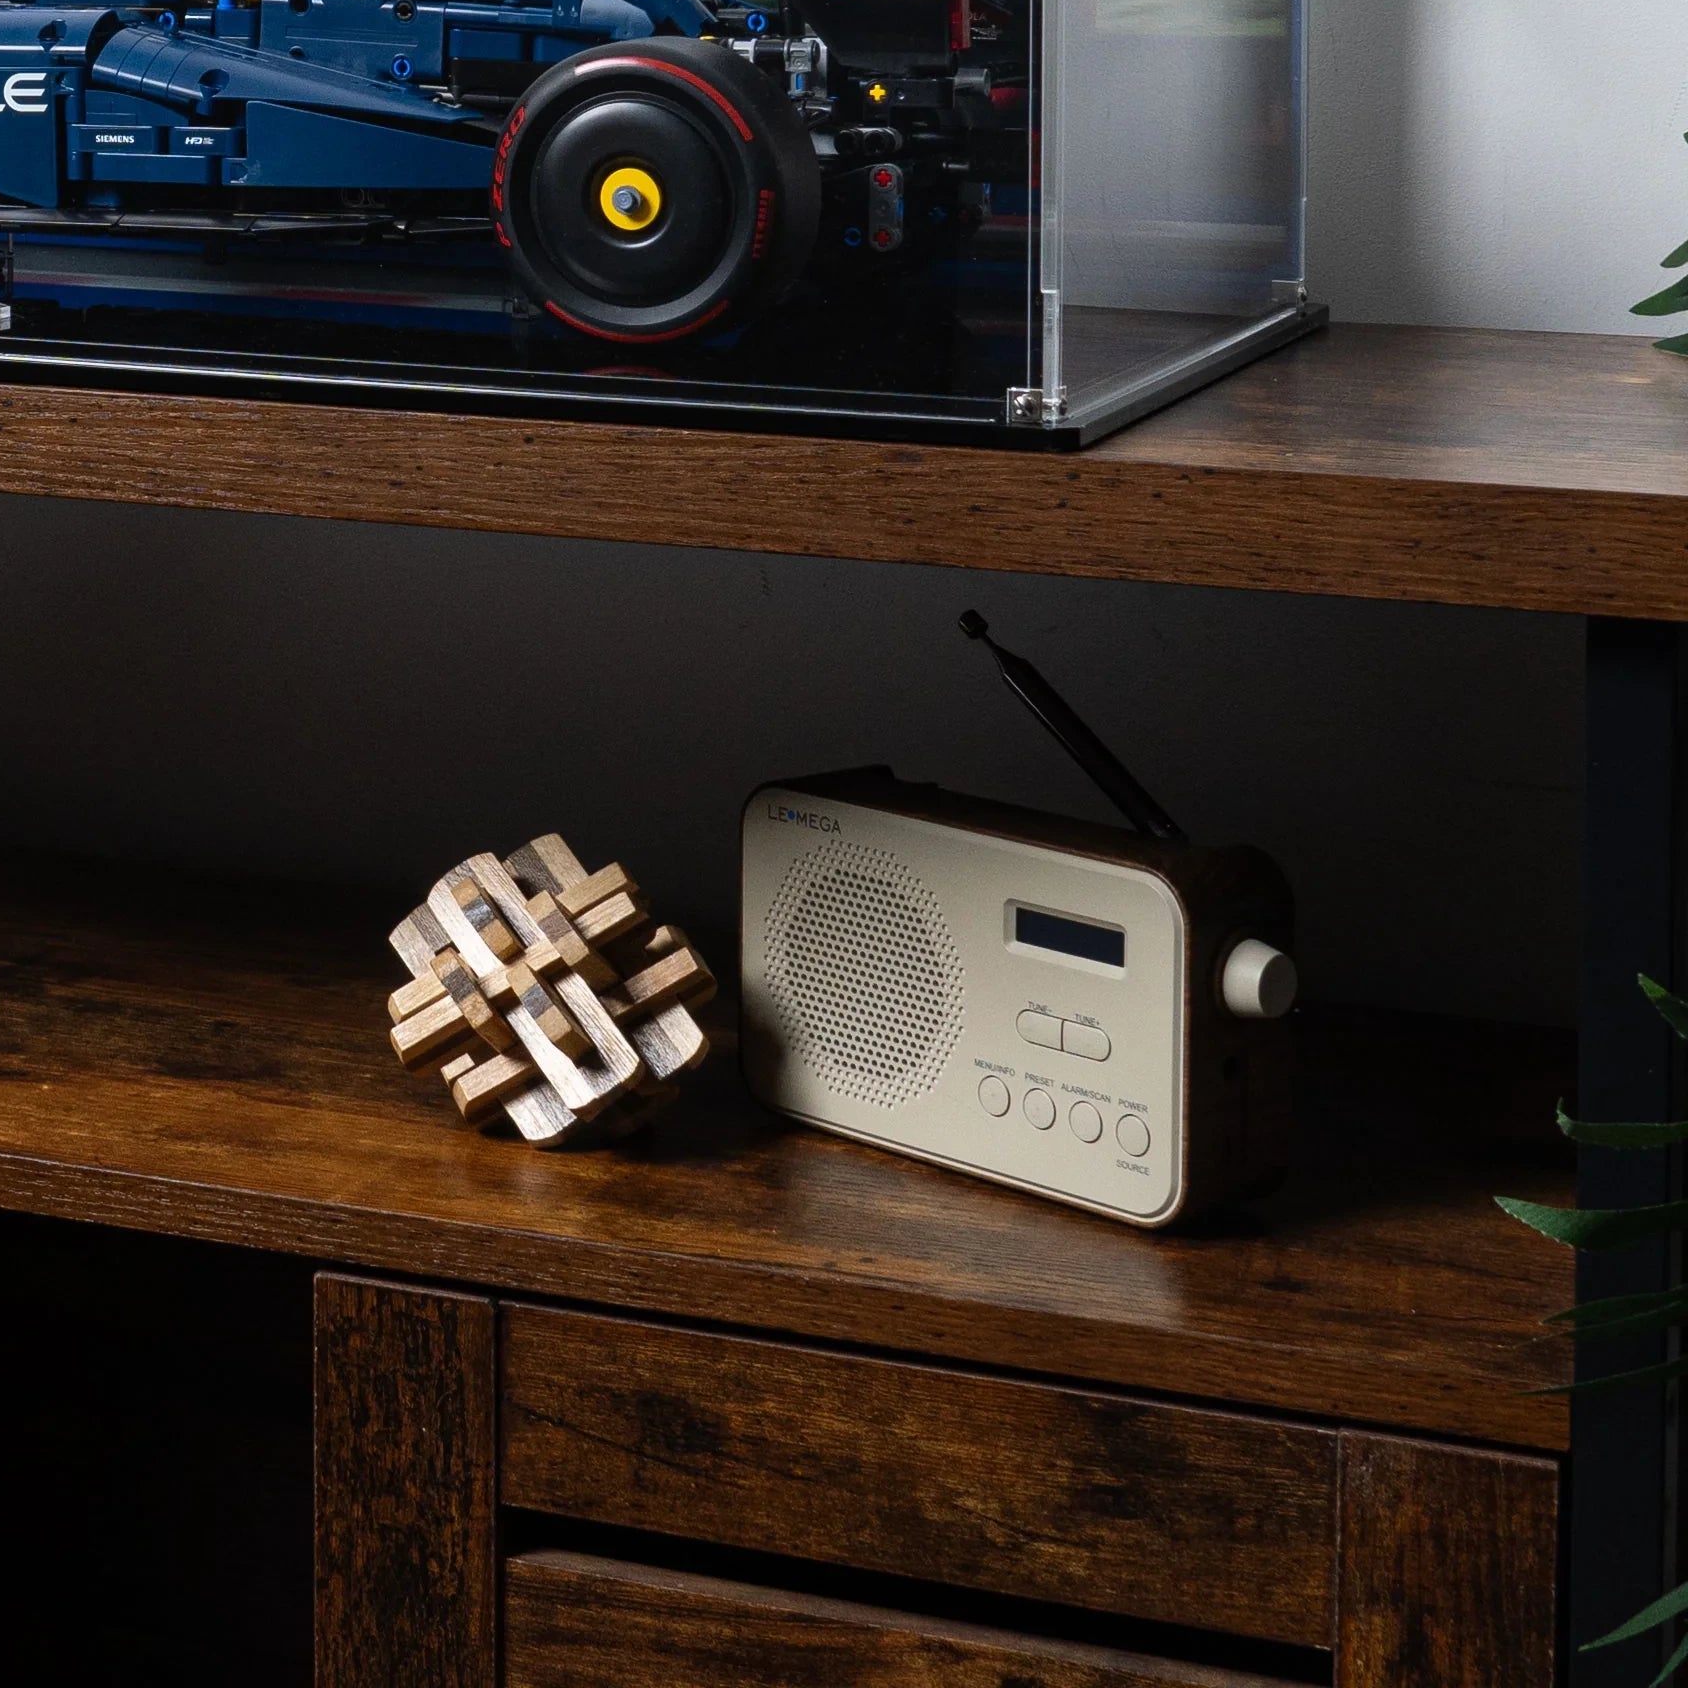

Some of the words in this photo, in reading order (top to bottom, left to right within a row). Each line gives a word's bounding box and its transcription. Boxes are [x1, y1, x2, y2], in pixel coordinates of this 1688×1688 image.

[95, 135, 135, 143] SIEMENS
[1025, 1072, 1054, 1087] PRESET
[1118, 1098, 1149, 1112] POWER
[1116, 1159, 1150, 1176] SOURCE
